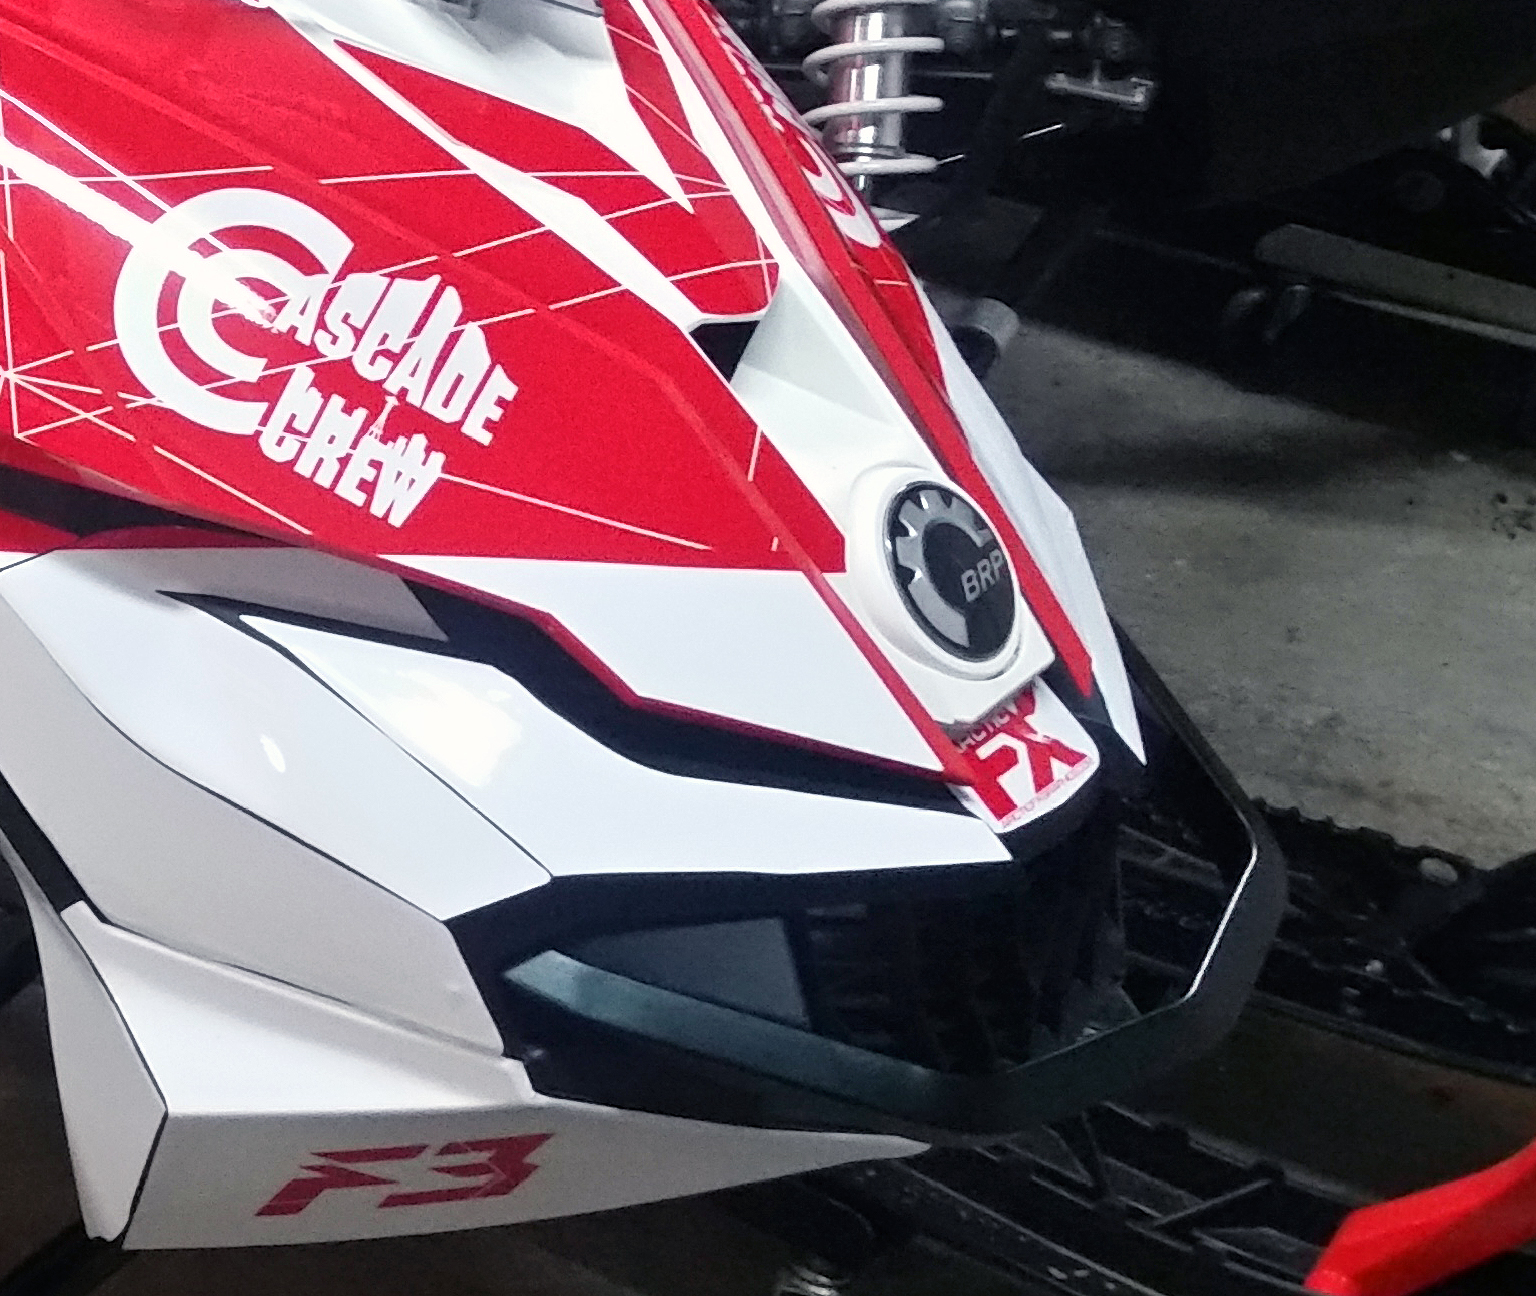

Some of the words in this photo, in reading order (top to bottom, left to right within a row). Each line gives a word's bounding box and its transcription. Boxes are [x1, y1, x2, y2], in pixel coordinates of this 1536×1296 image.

[258, 364, 447, 529] CREW
[961, 549, 1005, 603] BRP
[254, 1132, 557, 1217] F3
